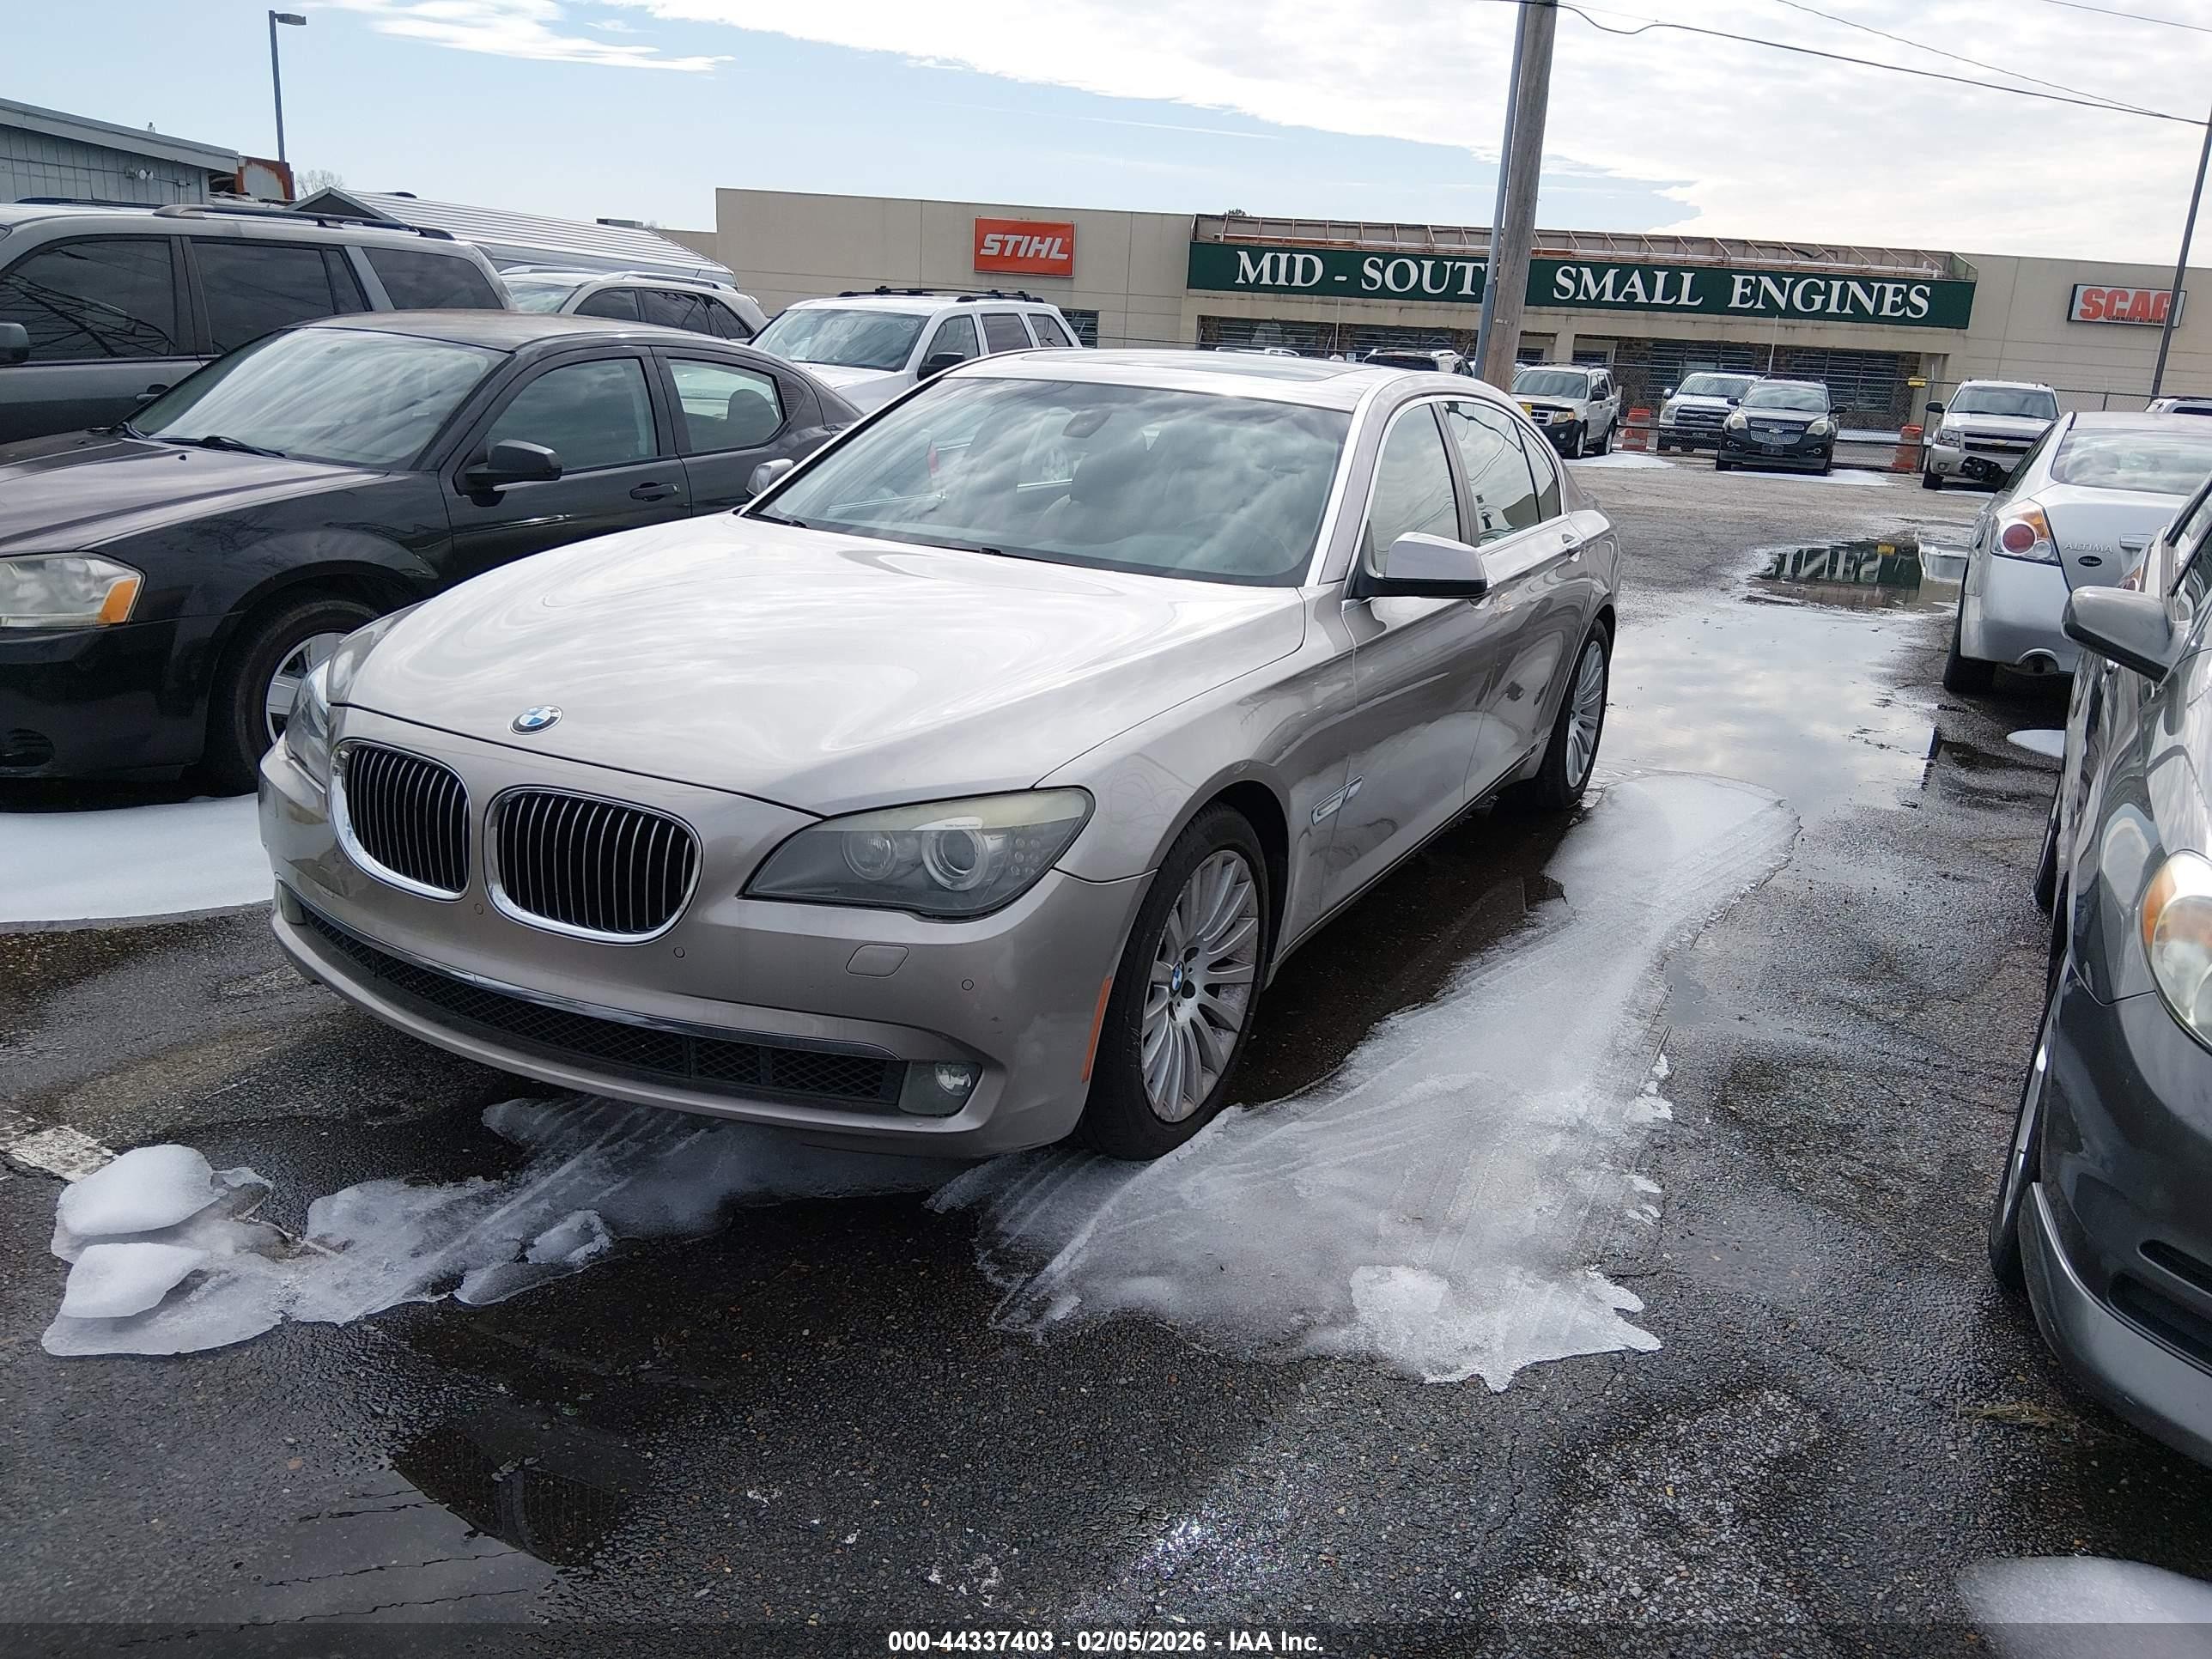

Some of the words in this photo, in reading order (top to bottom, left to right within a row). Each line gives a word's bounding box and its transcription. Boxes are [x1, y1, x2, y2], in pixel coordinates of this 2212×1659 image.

[980, 234, 1069, 260] STIHL
[1235, 251, 1324, 287] MID
[1361, 257, 1488, 296] SOUT
[1553, 265, 1704, 307] SMALL
[1728, 274, 1931, 319] ENGINES
[2064, 542, 2113, 554] ALTIMA
